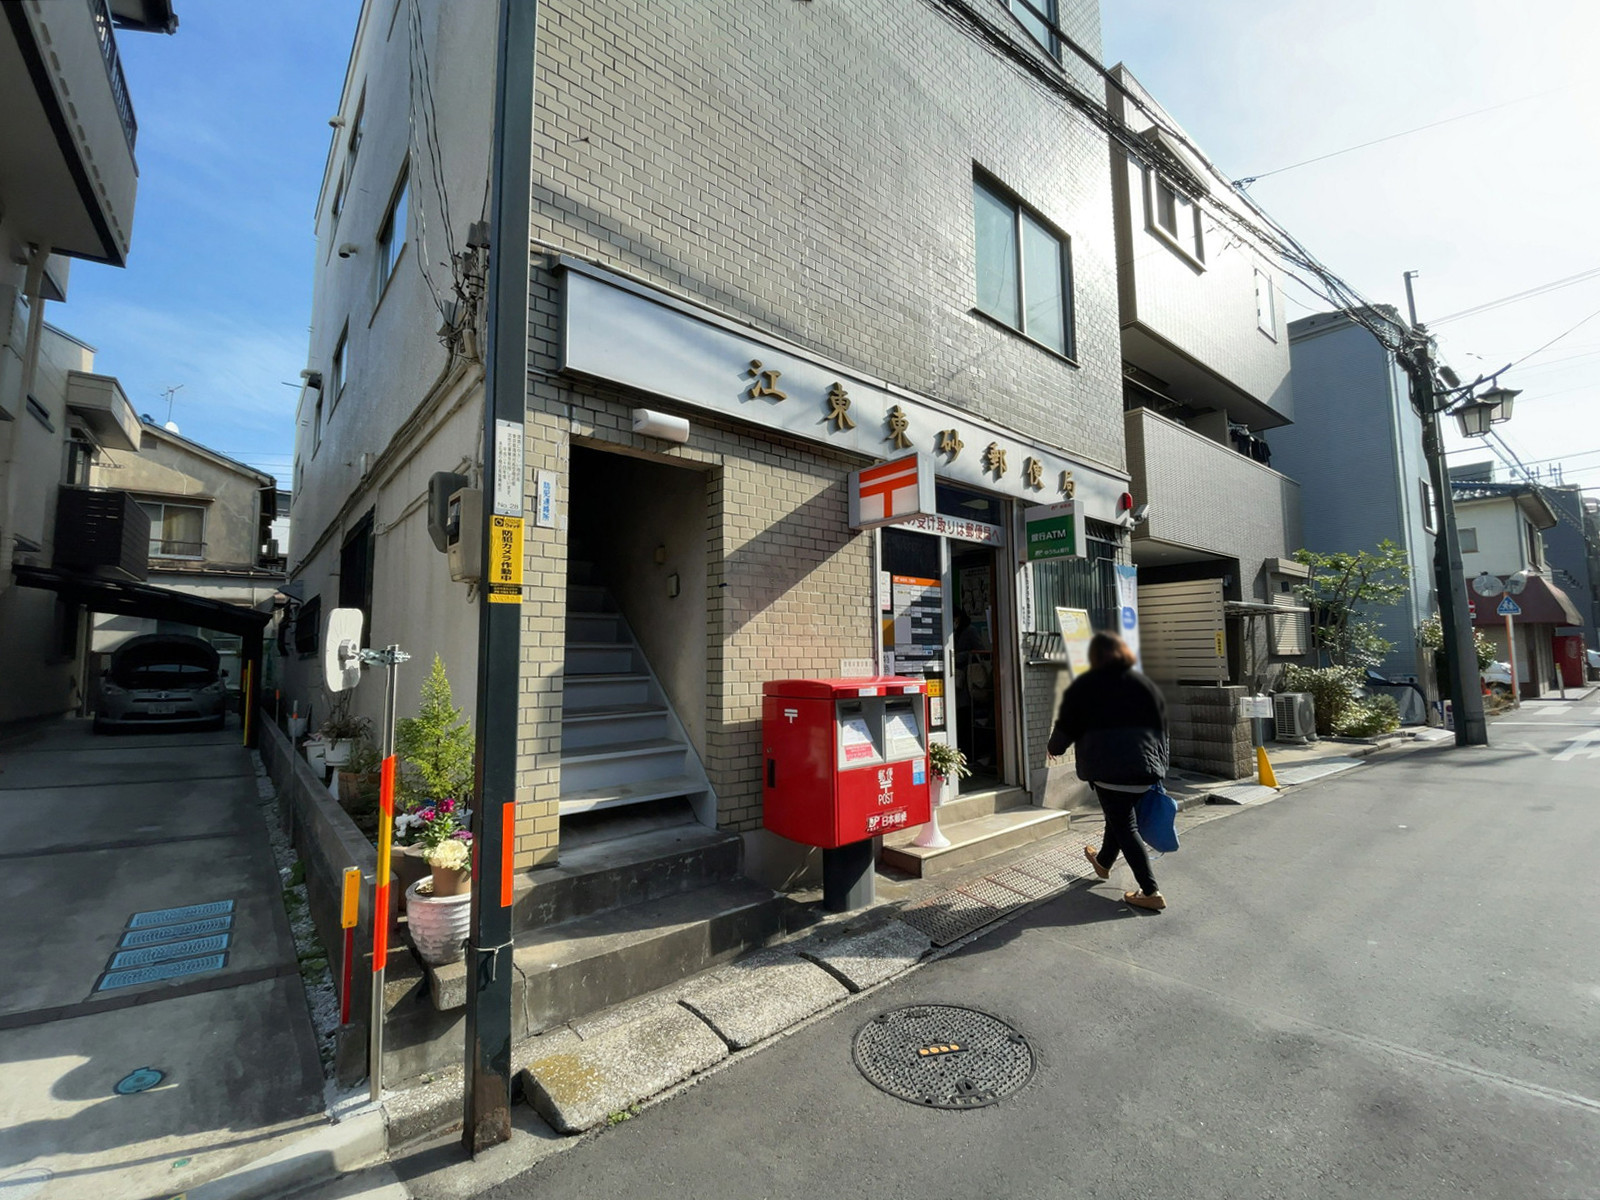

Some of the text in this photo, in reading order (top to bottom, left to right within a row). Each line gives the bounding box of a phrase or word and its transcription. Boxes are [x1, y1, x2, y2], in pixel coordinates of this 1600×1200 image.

[747, 358, 1076, 499] 江東東砂郵便局
[500, 529, 513, 582] 防犯カメラ作動中
[877, 767, 894, 783] 郵便
[877, 791, 895, 806] POST
